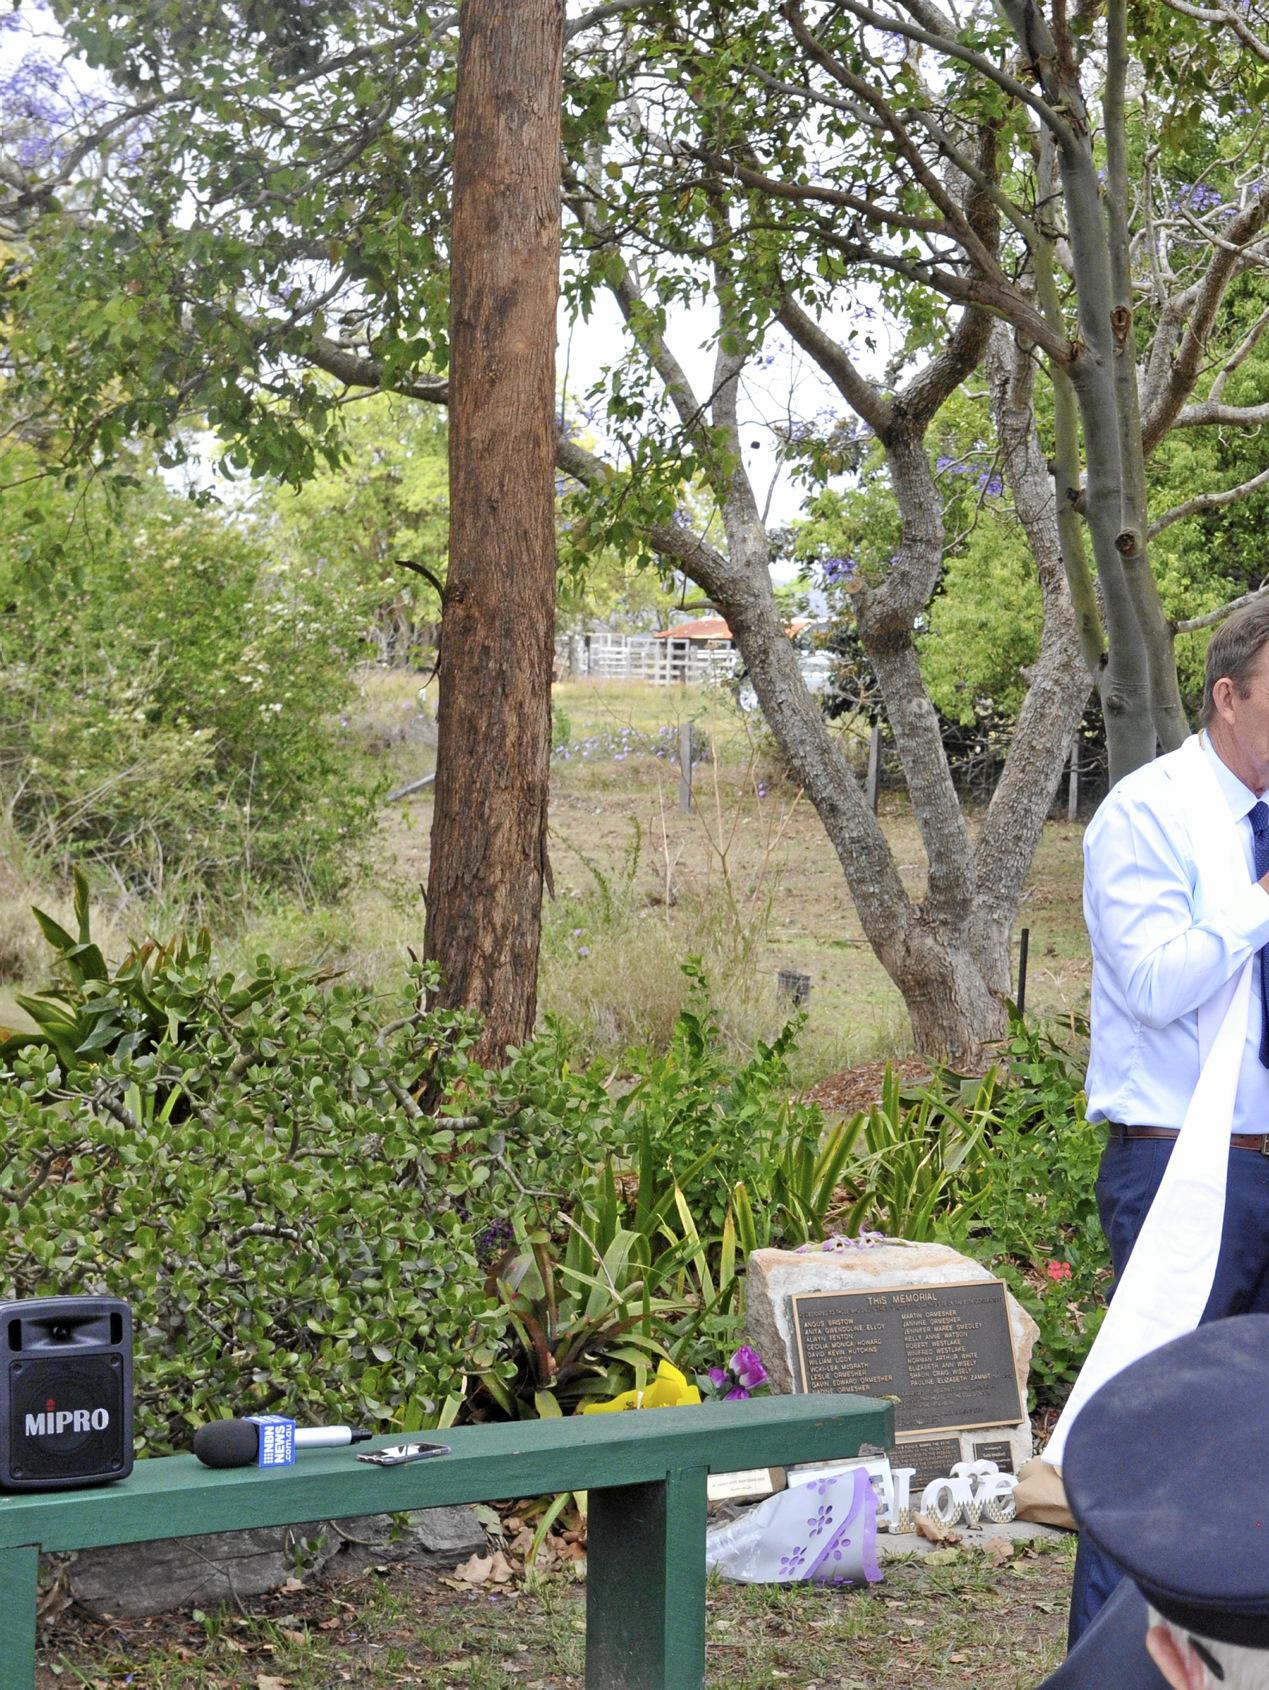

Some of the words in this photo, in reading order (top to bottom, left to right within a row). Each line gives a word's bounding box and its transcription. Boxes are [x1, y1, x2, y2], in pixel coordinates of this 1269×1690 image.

[867, 1296, 887, 1305] THIS
[892, 1292, 936, 1303] MEMORIAL
[263, 1425, 275, 1453] NBN
[274, 1425, 286, 1464] NEWS
[285, 1424, 293, 1462] .com.au
